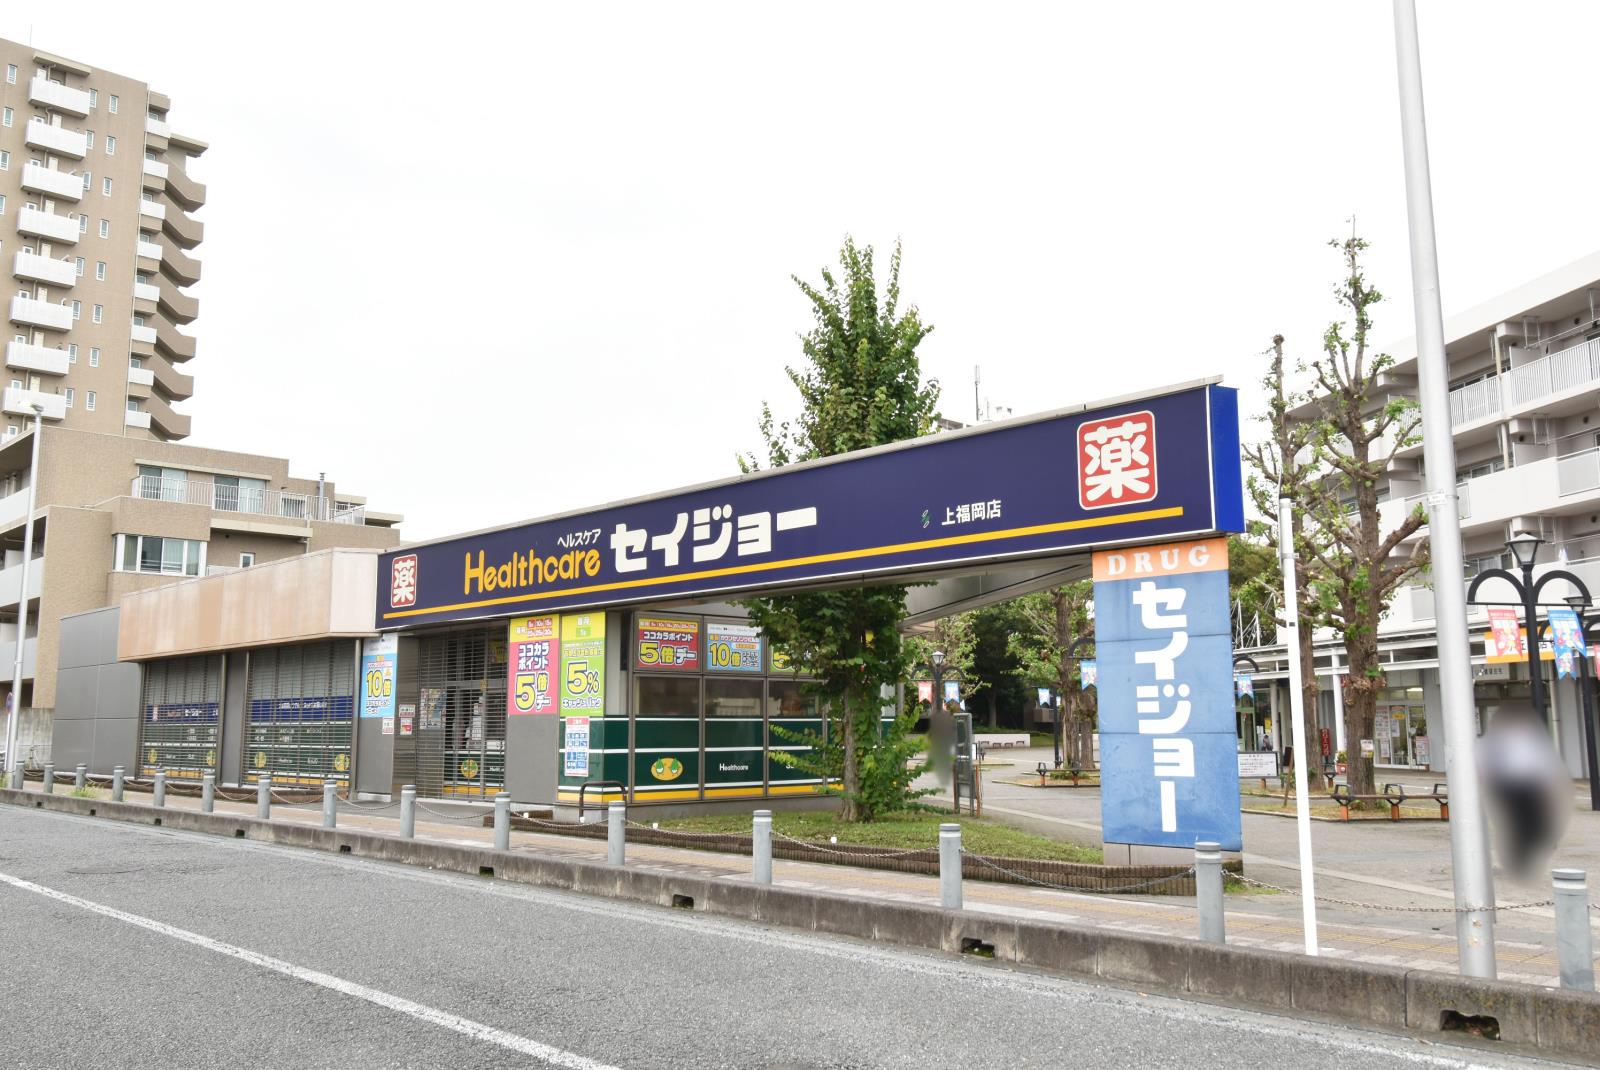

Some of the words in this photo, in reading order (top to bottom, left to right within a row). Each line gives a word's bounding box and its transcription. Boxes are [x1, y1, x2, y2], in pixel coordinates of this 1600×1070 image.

[1084, 421, 1150, 501] 薬
[941, 499, 1002, 526] 上福岡店
[557, 528, 602, 548] ヘルスケア
[610, 503, 818, 574] セイジョー
[464, 548, 601, 596] Healthcare
[1107, 545, 1211, 576] DRUG
[393, 559, 416, 603] 薬
[518, 641, 550, 657] ココカラ
[643, 631, 694, 642] ココカラポイント
[518, 656, 549, 671] ポイント
[638, 640, 698, 666] 5倍デー
[566, 660, 600, 695] 5%
[1132, 581, 1196, 833] セイジョー
[719, 763, 749, 772] Healthcare
